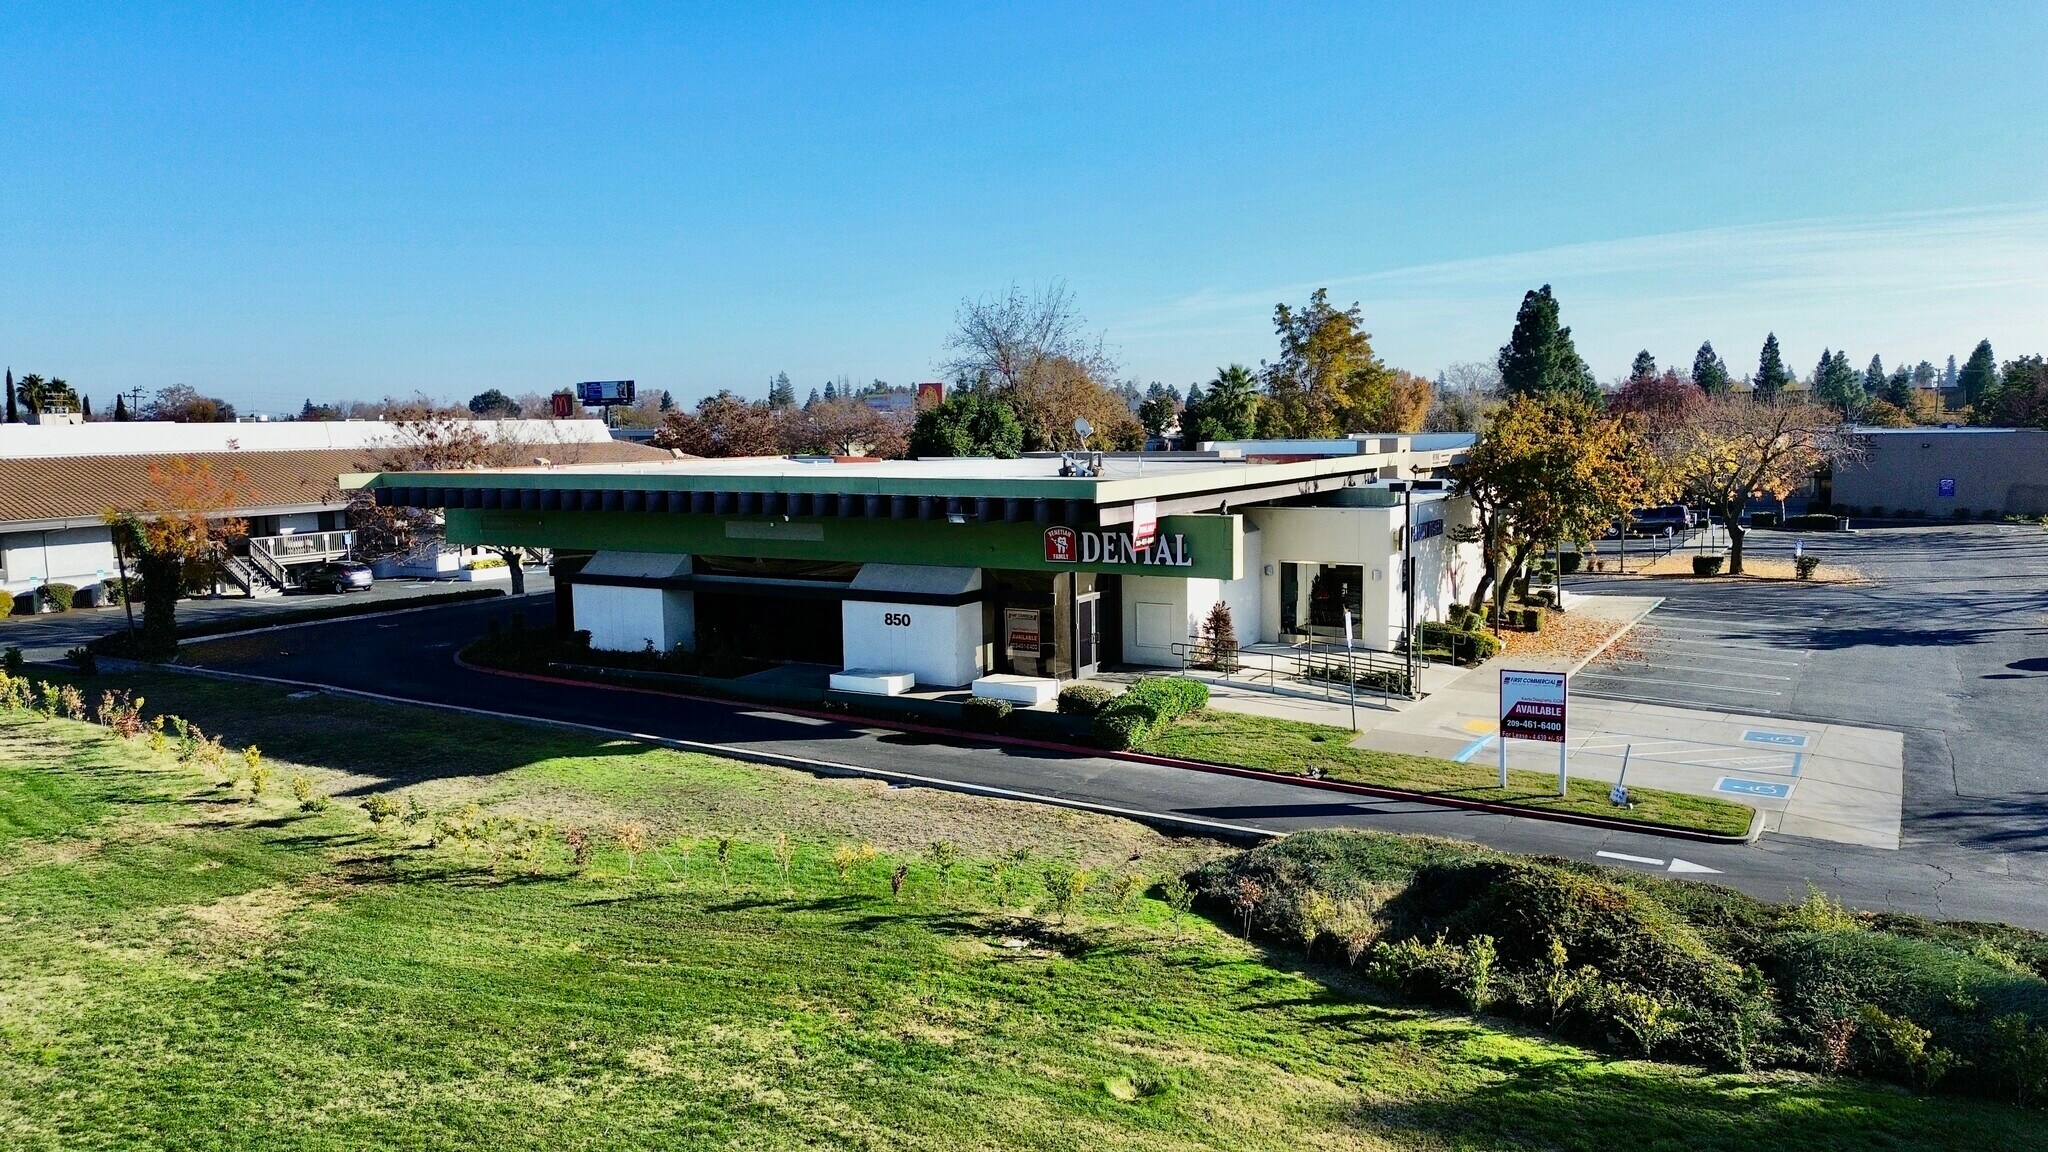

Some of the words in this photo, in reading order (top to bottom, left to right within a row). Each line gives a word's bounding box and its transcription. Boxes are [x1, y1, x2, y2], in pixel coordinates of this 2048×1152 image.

[1047, 529, 1072, 538] VENETIAN
[884, 612, 911, 627] 850
[1523, 677, 1556, 685] COMMERCIAL
[1515, 704, 1562, 717] AVAILABLE
[1506, 719, 1562, 731] 209-461-6400
[1512, 731, 1528, 739] Lease
